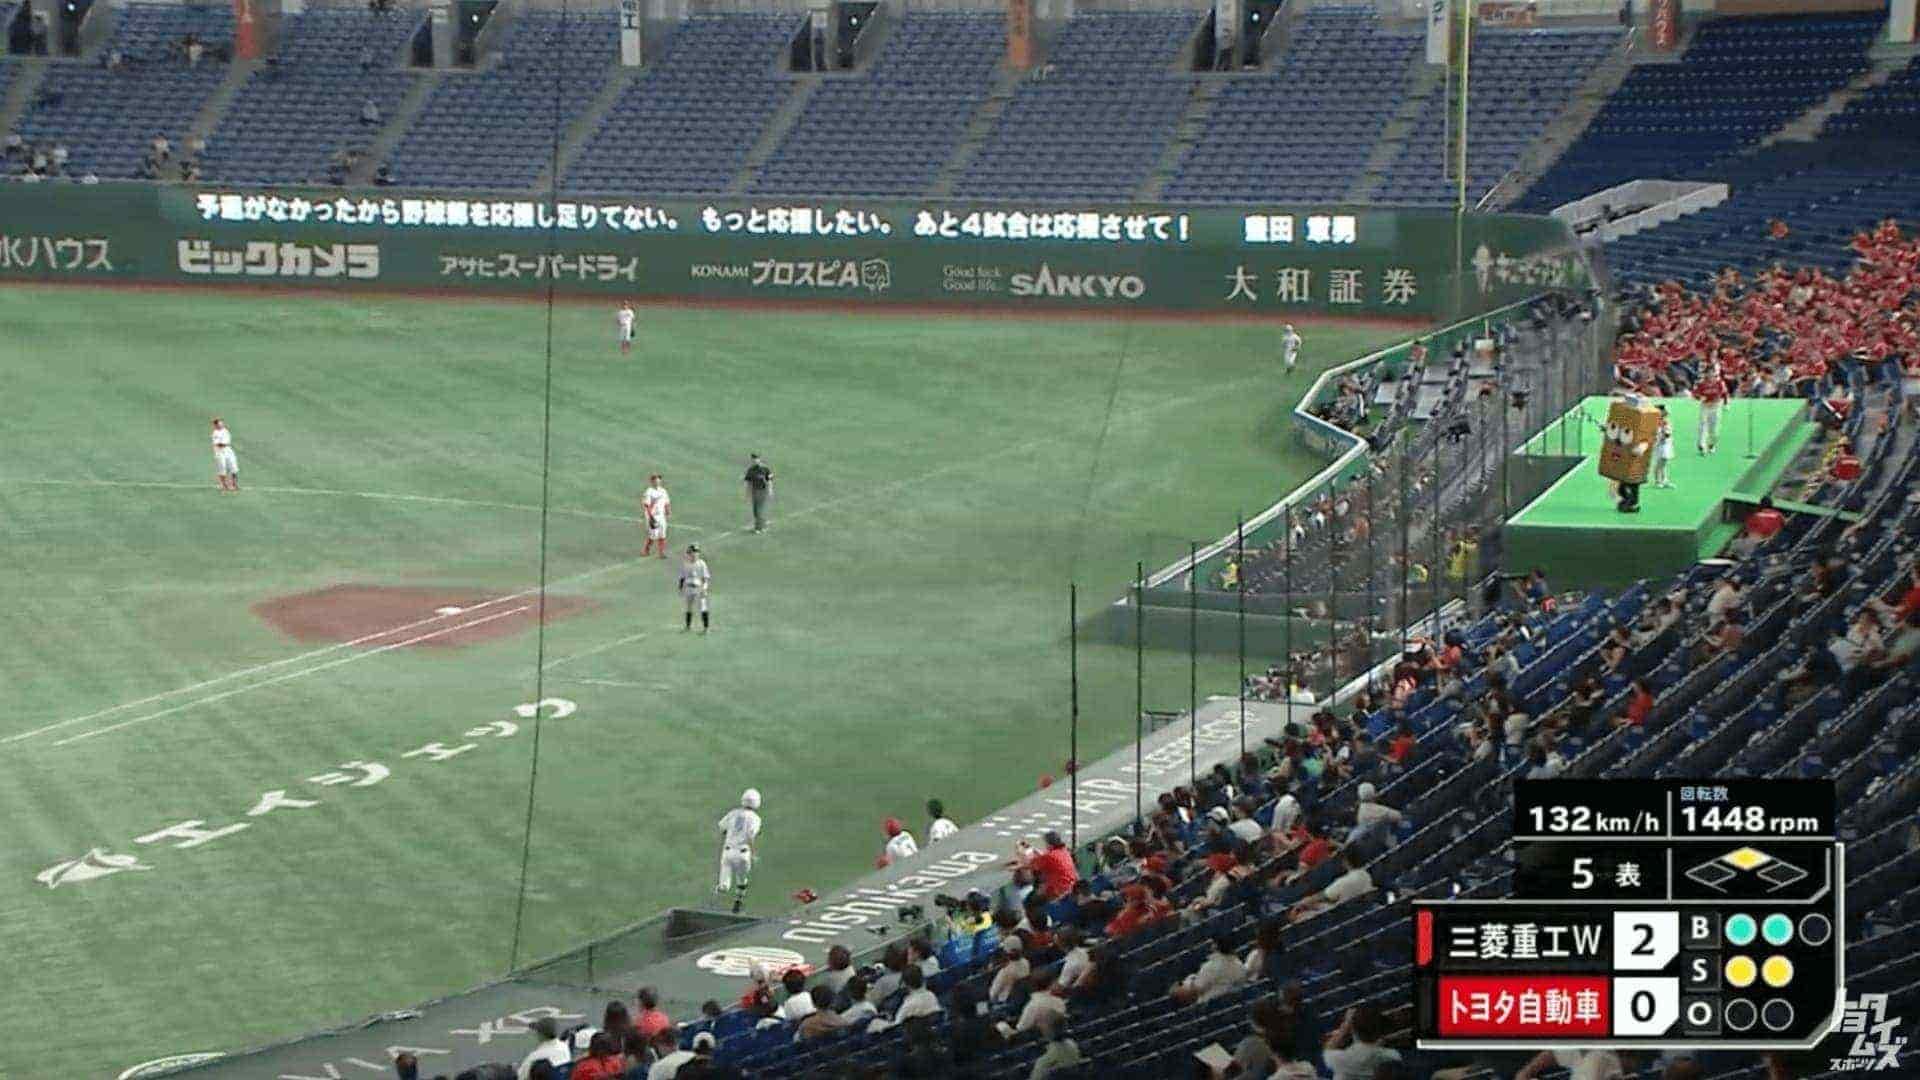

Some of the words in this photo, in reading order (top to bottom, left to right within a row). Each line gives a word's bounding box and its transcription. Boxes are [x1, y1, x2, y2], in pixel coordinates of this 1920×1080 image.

[177, 239, 380, 279] ビックカメラ
[691, 263, 749, 279] KONAMI
[752, 258, 859, 287] プロスピA
[1010, 261, 1145, 298] SANKYO
[1225, 265, 1418, 304] 大和証券
[783, 850, 998, 943] nishikawa
